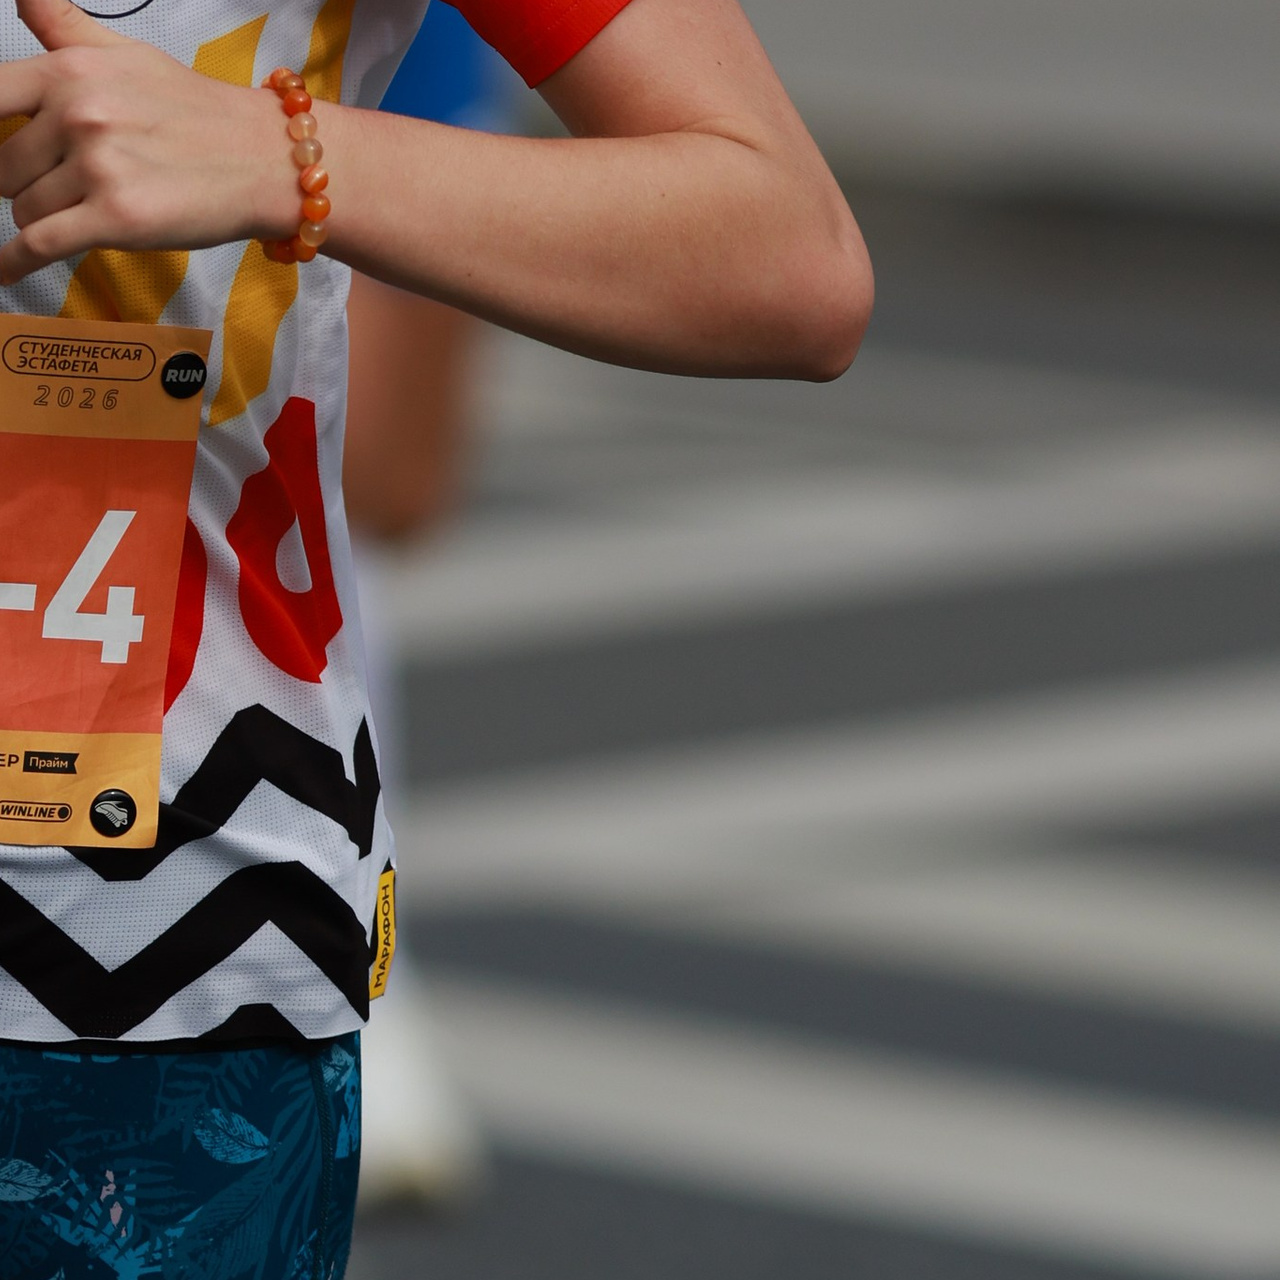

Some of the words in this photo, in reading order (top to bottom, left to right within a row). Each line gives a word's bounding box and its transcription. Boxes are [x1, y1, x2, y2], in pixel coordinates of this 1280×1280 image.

[18, 341, 143, 362] СТУДЕНЧЕСКАЯ
[16, 356, 99, 373] ЭСТАФЕТА
[165, 368, 205, 383] RUN
[33, 384, 120, 410] 2026
[29, 756, 69, 770] Прайм
[0, 804, 57, 819] WINLINE
[373, 883, 392, 989] МАРАФОН
